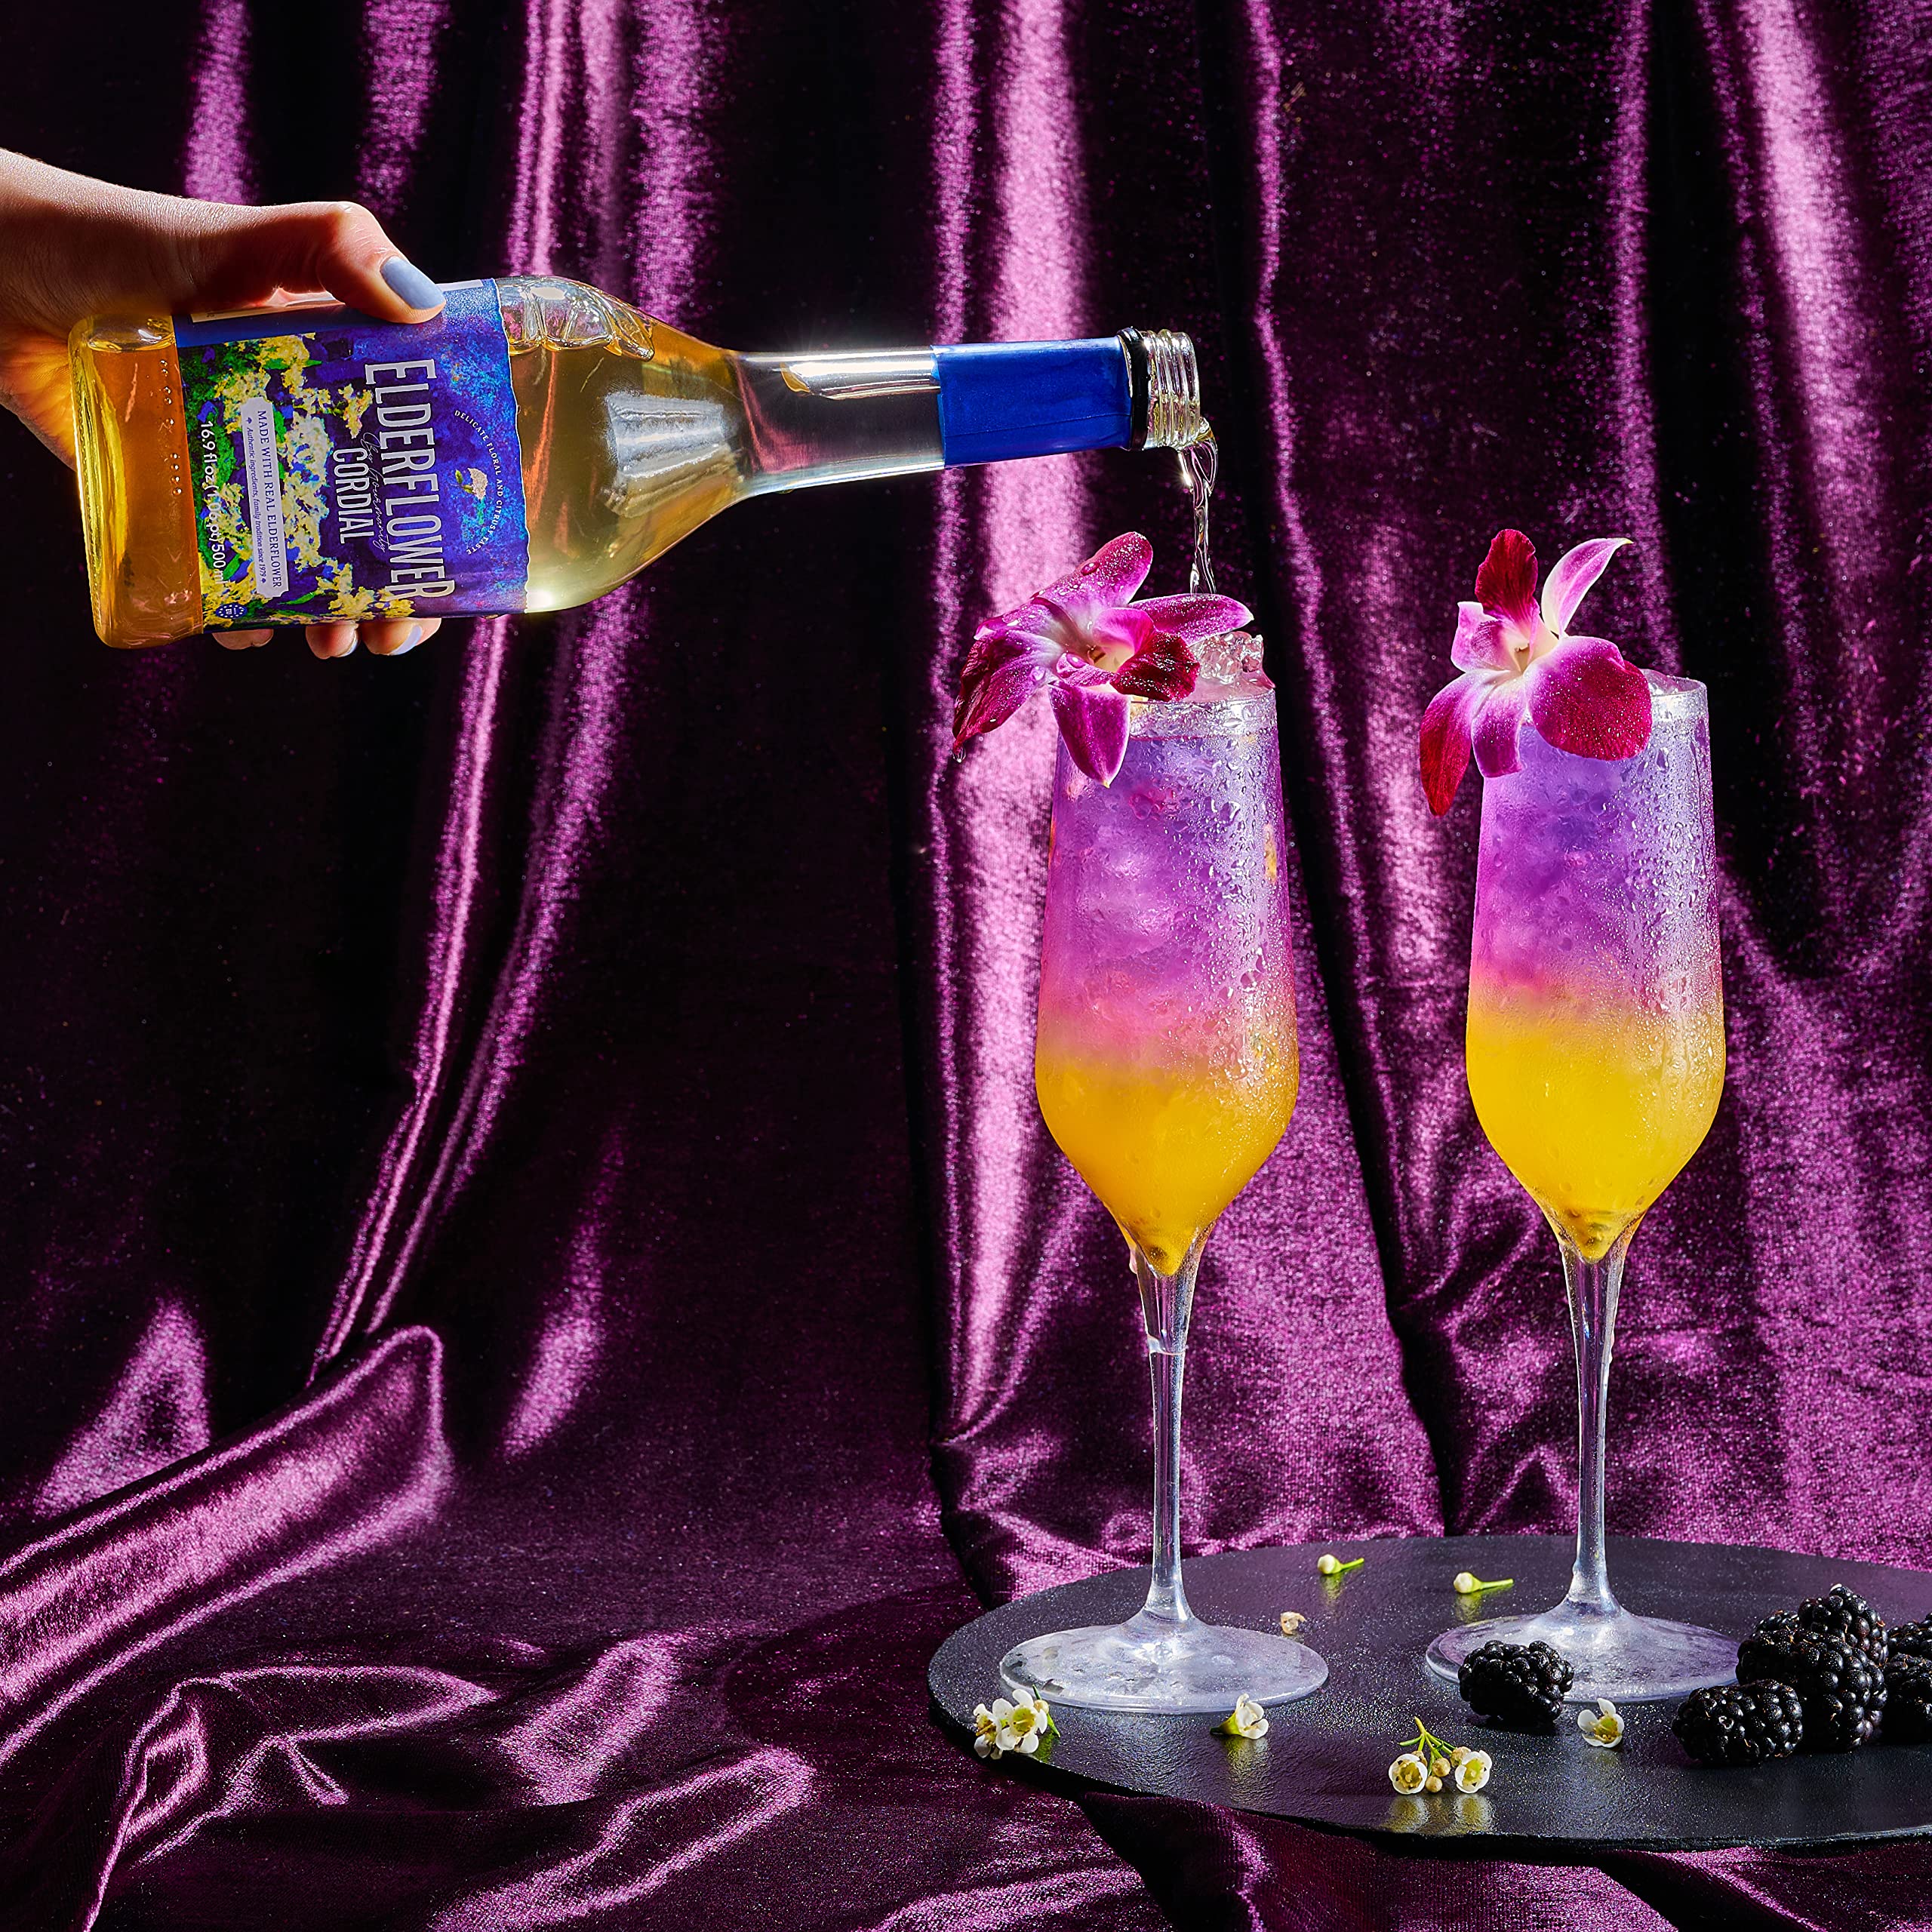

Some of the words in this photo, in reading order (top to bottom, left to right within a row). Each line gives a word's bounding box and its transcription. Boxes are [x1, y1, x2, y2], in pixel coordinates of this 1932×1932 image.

[201, 420, 216, 451] 16.9
[258, 411, 269, 444] MADE
[454, 410, 489, 441] DELICATE
[247, 427, 255, 459] Authentic
[486, 442, 501, 475] FLORAL
[261, 447, 272, 478] WITH
[249, 459, 259, 498] ingredients,
[365, 358, 455, 601] ELDERFLOWER
[253, 499, 261, 520] family
[264, 482, 275, 511] REAL
[333, 448, 375, 544] CORDIAL
[488, 500, 503, 534] CITRUSY
[255, 521, 263, 546] tradition
[466, 537, 489, 555] TASTE
[211, 544, 226, 568] 500
[267, 514, 282, 587] ELDERFLOWER
[214, 570, 229, 584] ml
